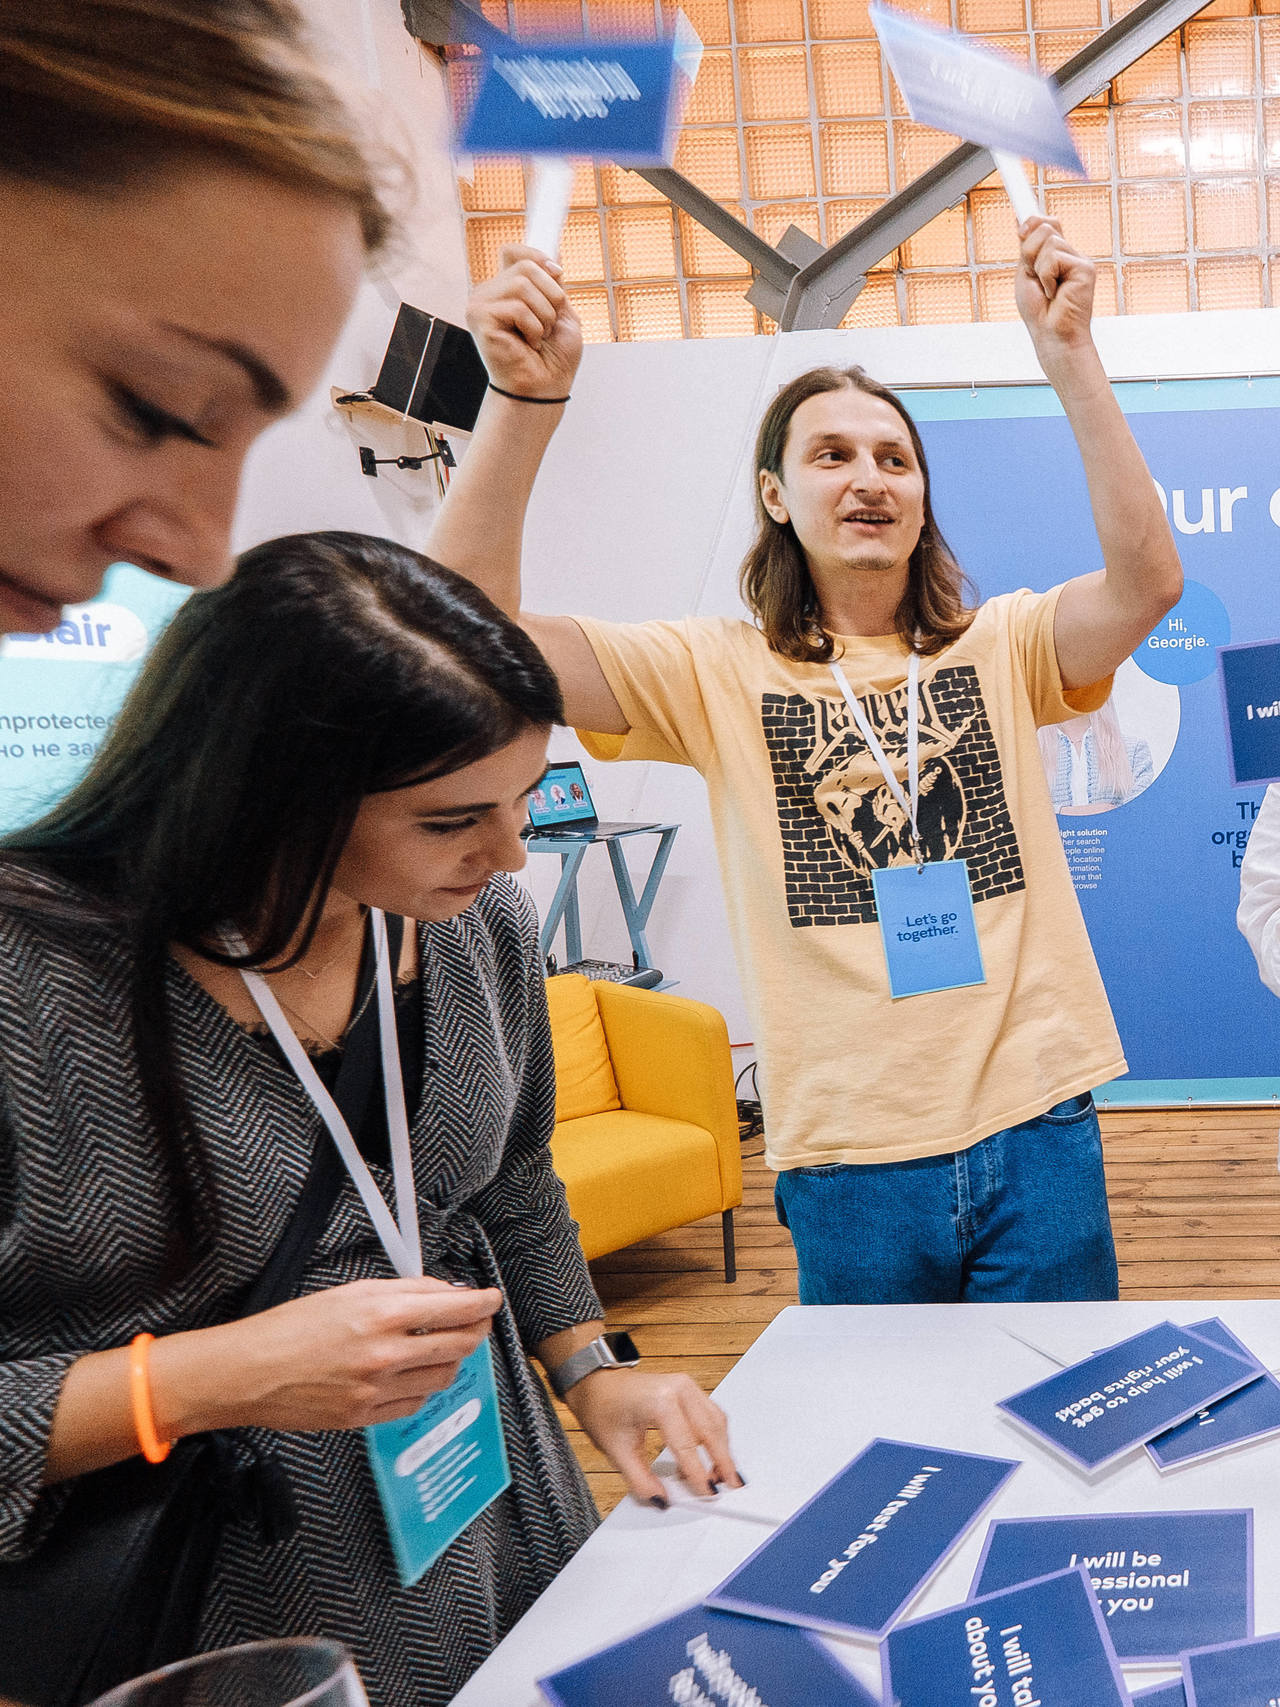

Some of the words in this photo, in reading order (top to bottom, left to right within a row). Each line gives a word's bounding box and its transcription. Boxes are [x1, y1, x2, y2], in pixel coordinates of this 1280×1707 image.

[8, 613, 111, 648] air
[1168, 618, 1187, 633] Hi,
[1147, 632, 1210, 651] Georgie.
[0, 713, 113, 733] nprotecte
[1247, 705, 1254, 720] I
[32, 743, 60, 757] не
[1236, 801, 1261, 820] Th
[941, 912, 958, 926] go
[896, 924, 959, 943] together.
[1154, 1345, 1190, 1370] your
[1103, 1365, 1154, 1395] rights
[1163, 1361, 1193, 1381] will
[1127, 1375, 1167, 1398] help
[1105, 1395, 1129, 1409] to
[1071, 1405, 1105, 1429] get
[895, 1473, 934, 1500] will
[864, 1499, 910, 1533] test
[841, 1532, 880, 1560] for
[1082, 1550, 1127, 1570] will
[1132, 1550, 1163, 1568] be
[808, 1558, 850, 1595] you
[1091, 1569, 1190, 1591] essional
[1106, 1597, 1154, 1617] you
[965, 1616, 996, 1682] about
[1003, 1635, 1033, 1678] will
[970, 1679, 998, 1707] yo
